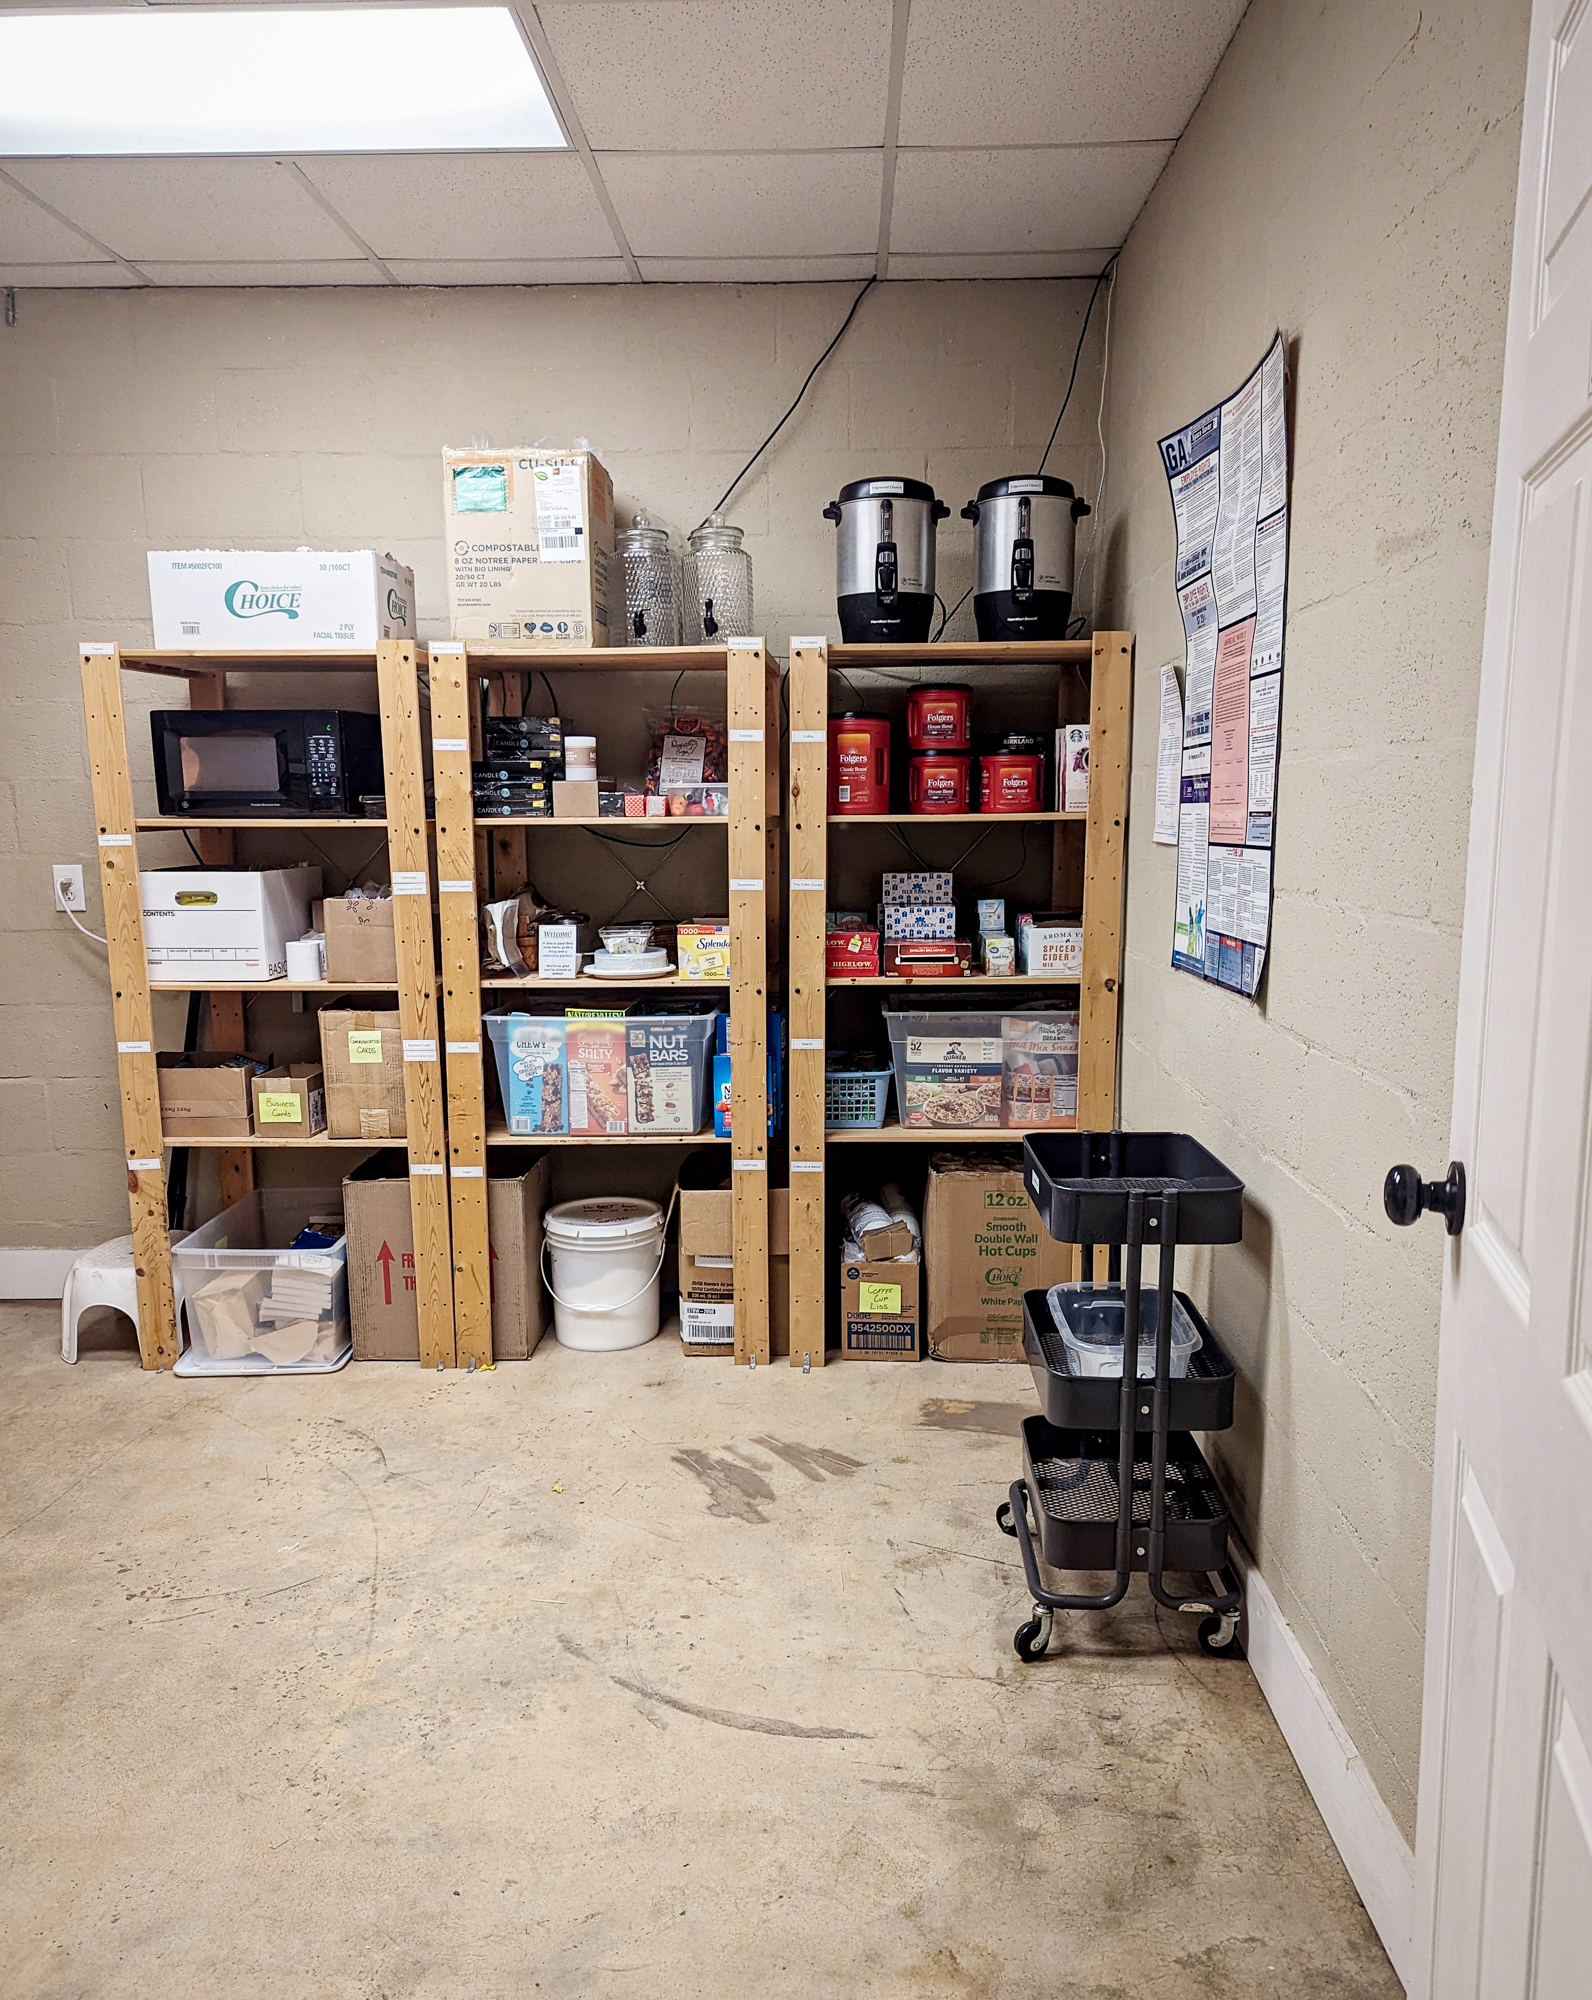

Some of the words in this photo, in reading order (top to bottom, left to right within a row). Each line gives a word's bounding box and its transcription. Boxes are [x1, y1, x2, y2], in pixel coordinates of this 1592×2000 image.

[1165, 438, 1188, 471] GA
[172, 562, 188, 570] ITEM
[224, 580, 302, 620] CHOICE
[313, 632, 333, 640] FACIAL
[334, 632, 355, 640] TISSUE
[926, 713, 954, 723] Folgers
[839, 752, 868, 763] Folgers
[928, 778, 954, 788] Folgers
[1002, 778, 1028, 788] Folgers
[1043, 932, 1072, 940] AROMA
[632, 1032, 644, 1040] 30
[649, 1035, 688, 1049] NUT
[911, 1042, 921, 1051] 52
[1029, 1043, 1047, 1052] Mix
[578, 1049, 613, 1059] SALTY
[650, 1050, 688, 1061] BARS
[266, 1097, 295, 1107] Business
[272, 1109, 291, 1118] Cards
[986, 1192, 1004, 1206] 12
[1007, 1196, 1027, 1207] oz.
[986, 1222, 1026, 1232] Smooth
[974, 1234, 1011, 1244] Double
[1014, 1234, 1038, 1244] Wall
[979, 1246, 1002, 1256] Hot
[1005, 1246, 1036, 1258] Cups
[851, 1324, 911, 1333] 9542500DX
